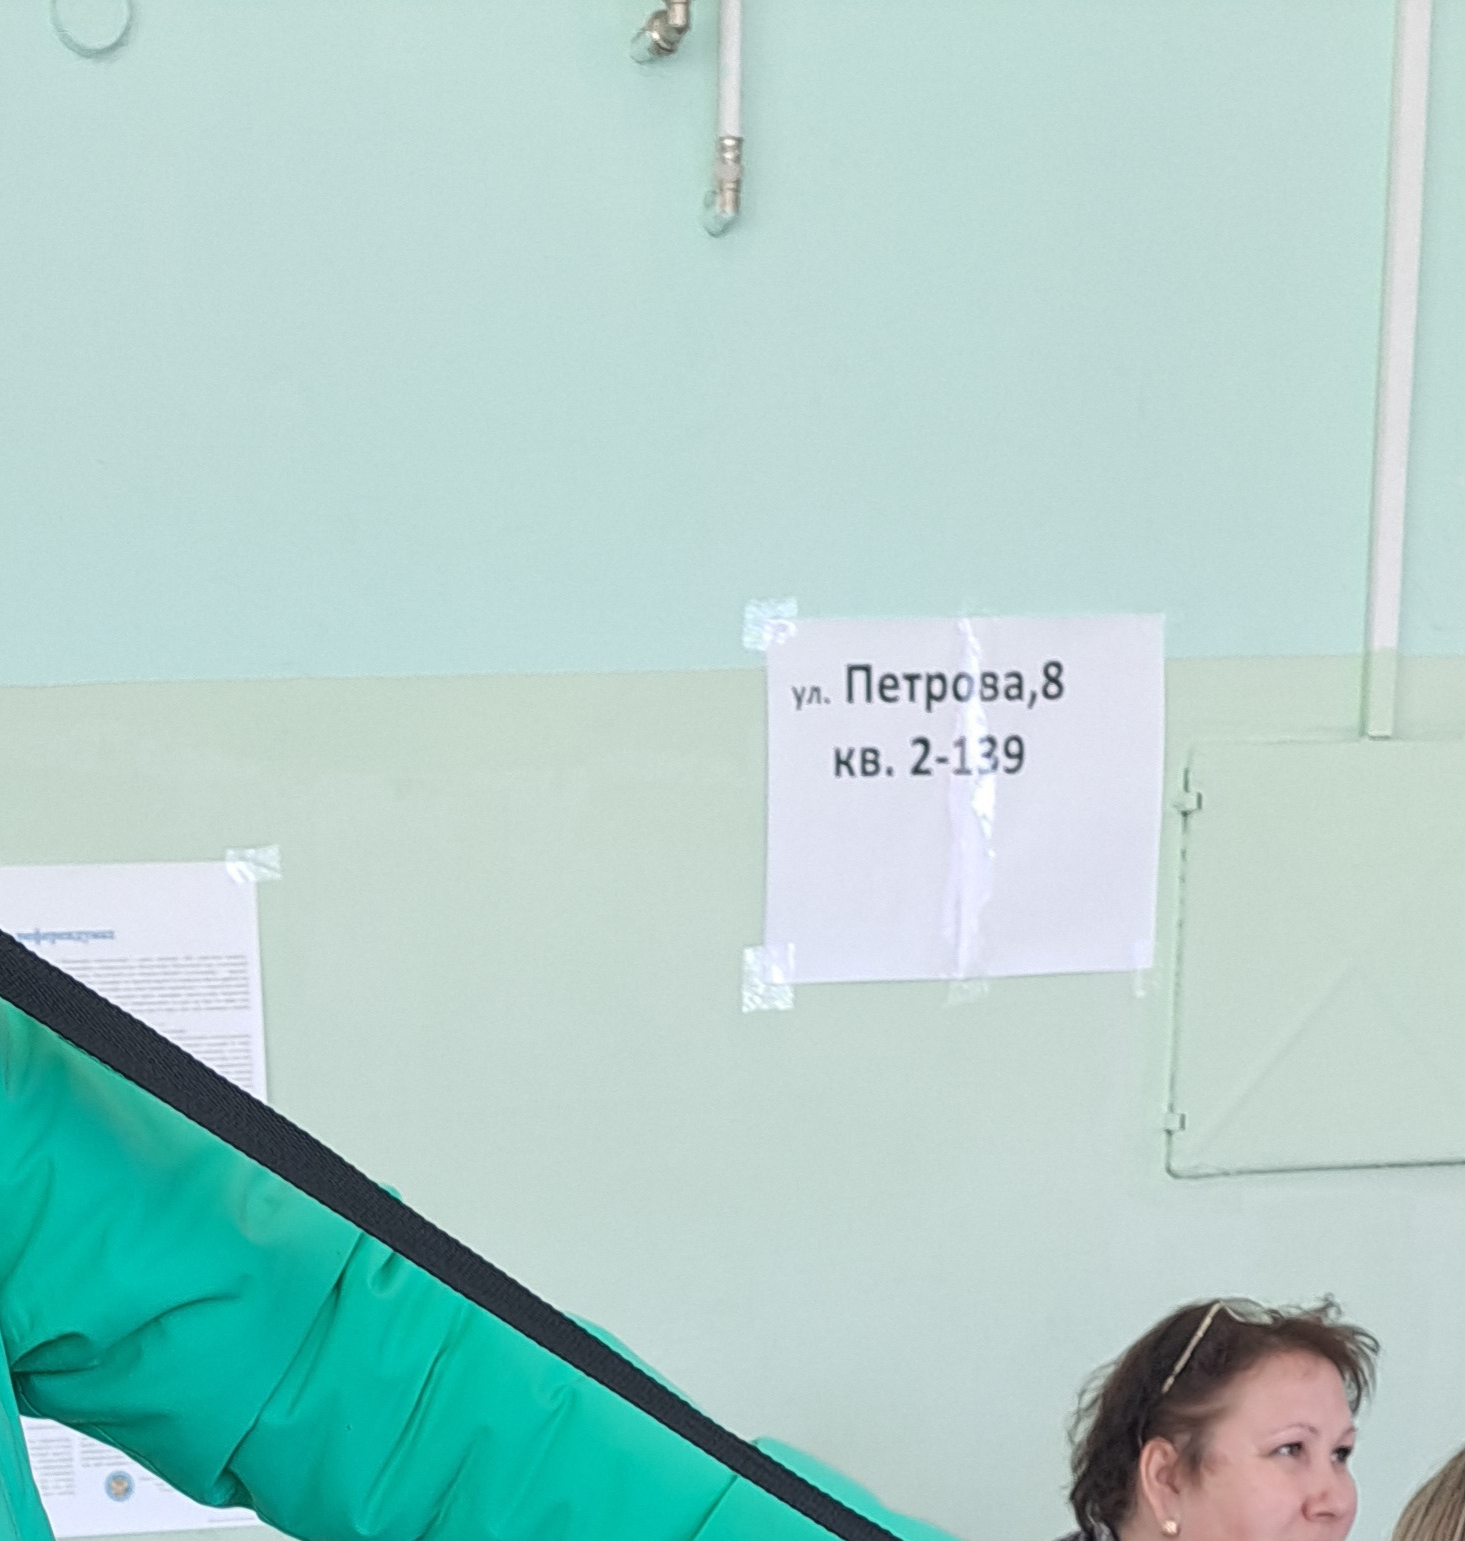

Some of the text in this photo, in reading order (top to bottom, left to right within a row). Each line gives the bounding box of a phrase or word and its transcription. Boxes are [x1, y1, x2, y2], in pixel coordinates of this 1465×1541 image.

[791, 660, 1064, 713] ул. Петрова,8
[834, 734, 1025, 777] кв. 2-139
